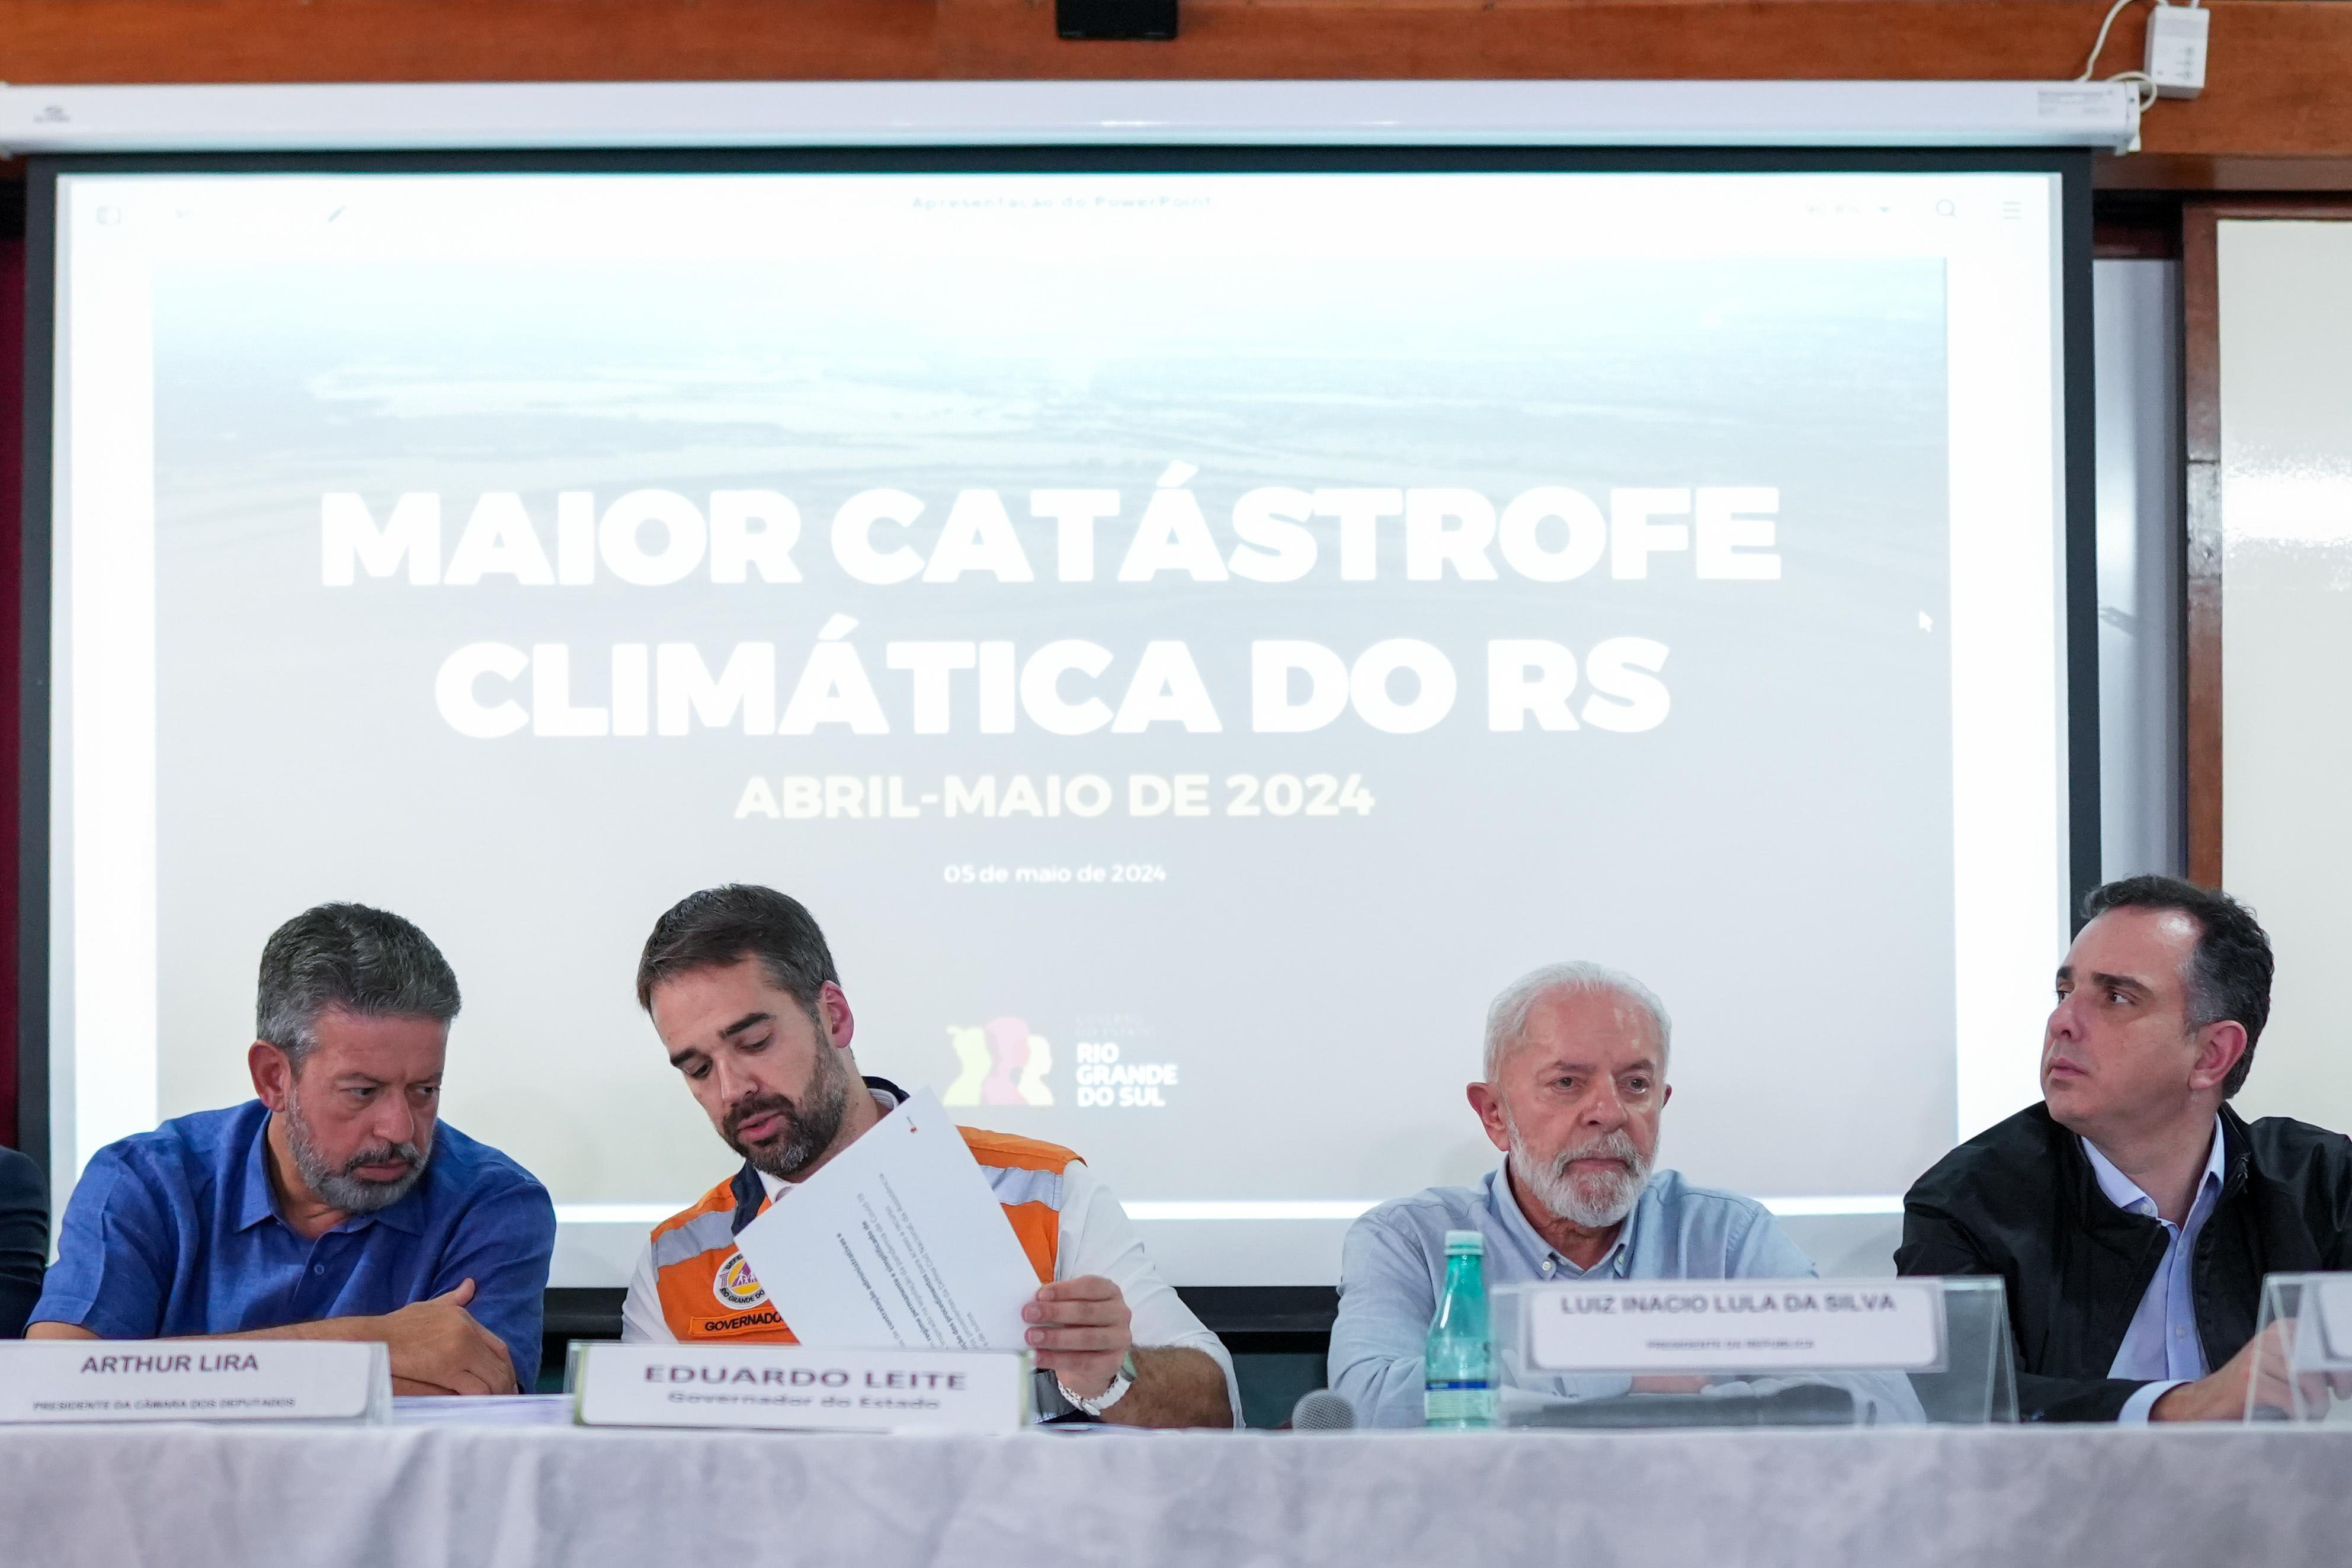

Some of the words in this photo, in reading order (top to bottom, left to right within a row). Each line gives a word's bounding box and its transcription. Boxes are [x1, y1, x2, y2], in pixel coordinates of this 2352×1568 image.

[1062, 195, 1086, 207] do
[1094, 195, 1212, 207] PowerPoint
[322, 489, 803, 586] MAIOR
[831, 460, 1781, 585] CATÁSTROFE
[435, 613, 1223, 739] CLIMÁTICA
[1252, 637, 1457, 735] DO
[1488, 636, 1671, 733] RS
[734, 774, 1113, 819] ABRIL-MAIO
[1129, 774, 1210, 816] DE
[1226, 772, 1376, 816] 2024
[944, 864, 976, 883] 05
[980, 864, 1008, 883] de
[1015, 864, 1071, 883] maio
[1077, 863, 1105, 883] de
[1111, 863, 1167, 883] 2024
[1076, 1042, 1119, 1063] RIO
[1076, 1064, 1178, 1085] GRANDE
[1077, 1086, 1114, 1107] DO
[1119, 1086, 1166, 1107] SUL
[725, 1253, 744, 1269] DEFE
[866, 1230, 893, 1272] simplificado
[838, 1237, 871, 1290] administrativas
[719, 1287, 729, 1297] RIO
[729, 1295, 755, 1304] GRANDE
[755, 1289, 765, 1298] DO
[892, 1277, 919, 1317] permanente
[921, 1274, 953, 1323] procedimentos
[1560, 1295, 1617, 1314] LUIZ
[1713, 1295, 1776, 1313] LULA
[1783, 1294, 1818, 1313] DA
[1824, 1293, 1896, 1313] SILVA
[867, 1290, 895, 1330] contratação
[705, 1312, 783, 1331] GOVERNADO
[914, 1317, 931, 1341] regime
[948, 1322, 959, 1336] dos
[81, 1354, 191, 1374] ARTHUR
[199, 1353, 259, 1372] LIRA
[645, 1364, 850, 1389] EDUARDO
[864, 1368, 967, 1391] LEITE
[668, 1392, 812, 1409] Governador
[821, 1394, 851, 1409] do
[858, 1396, 940, 1411] Estado
